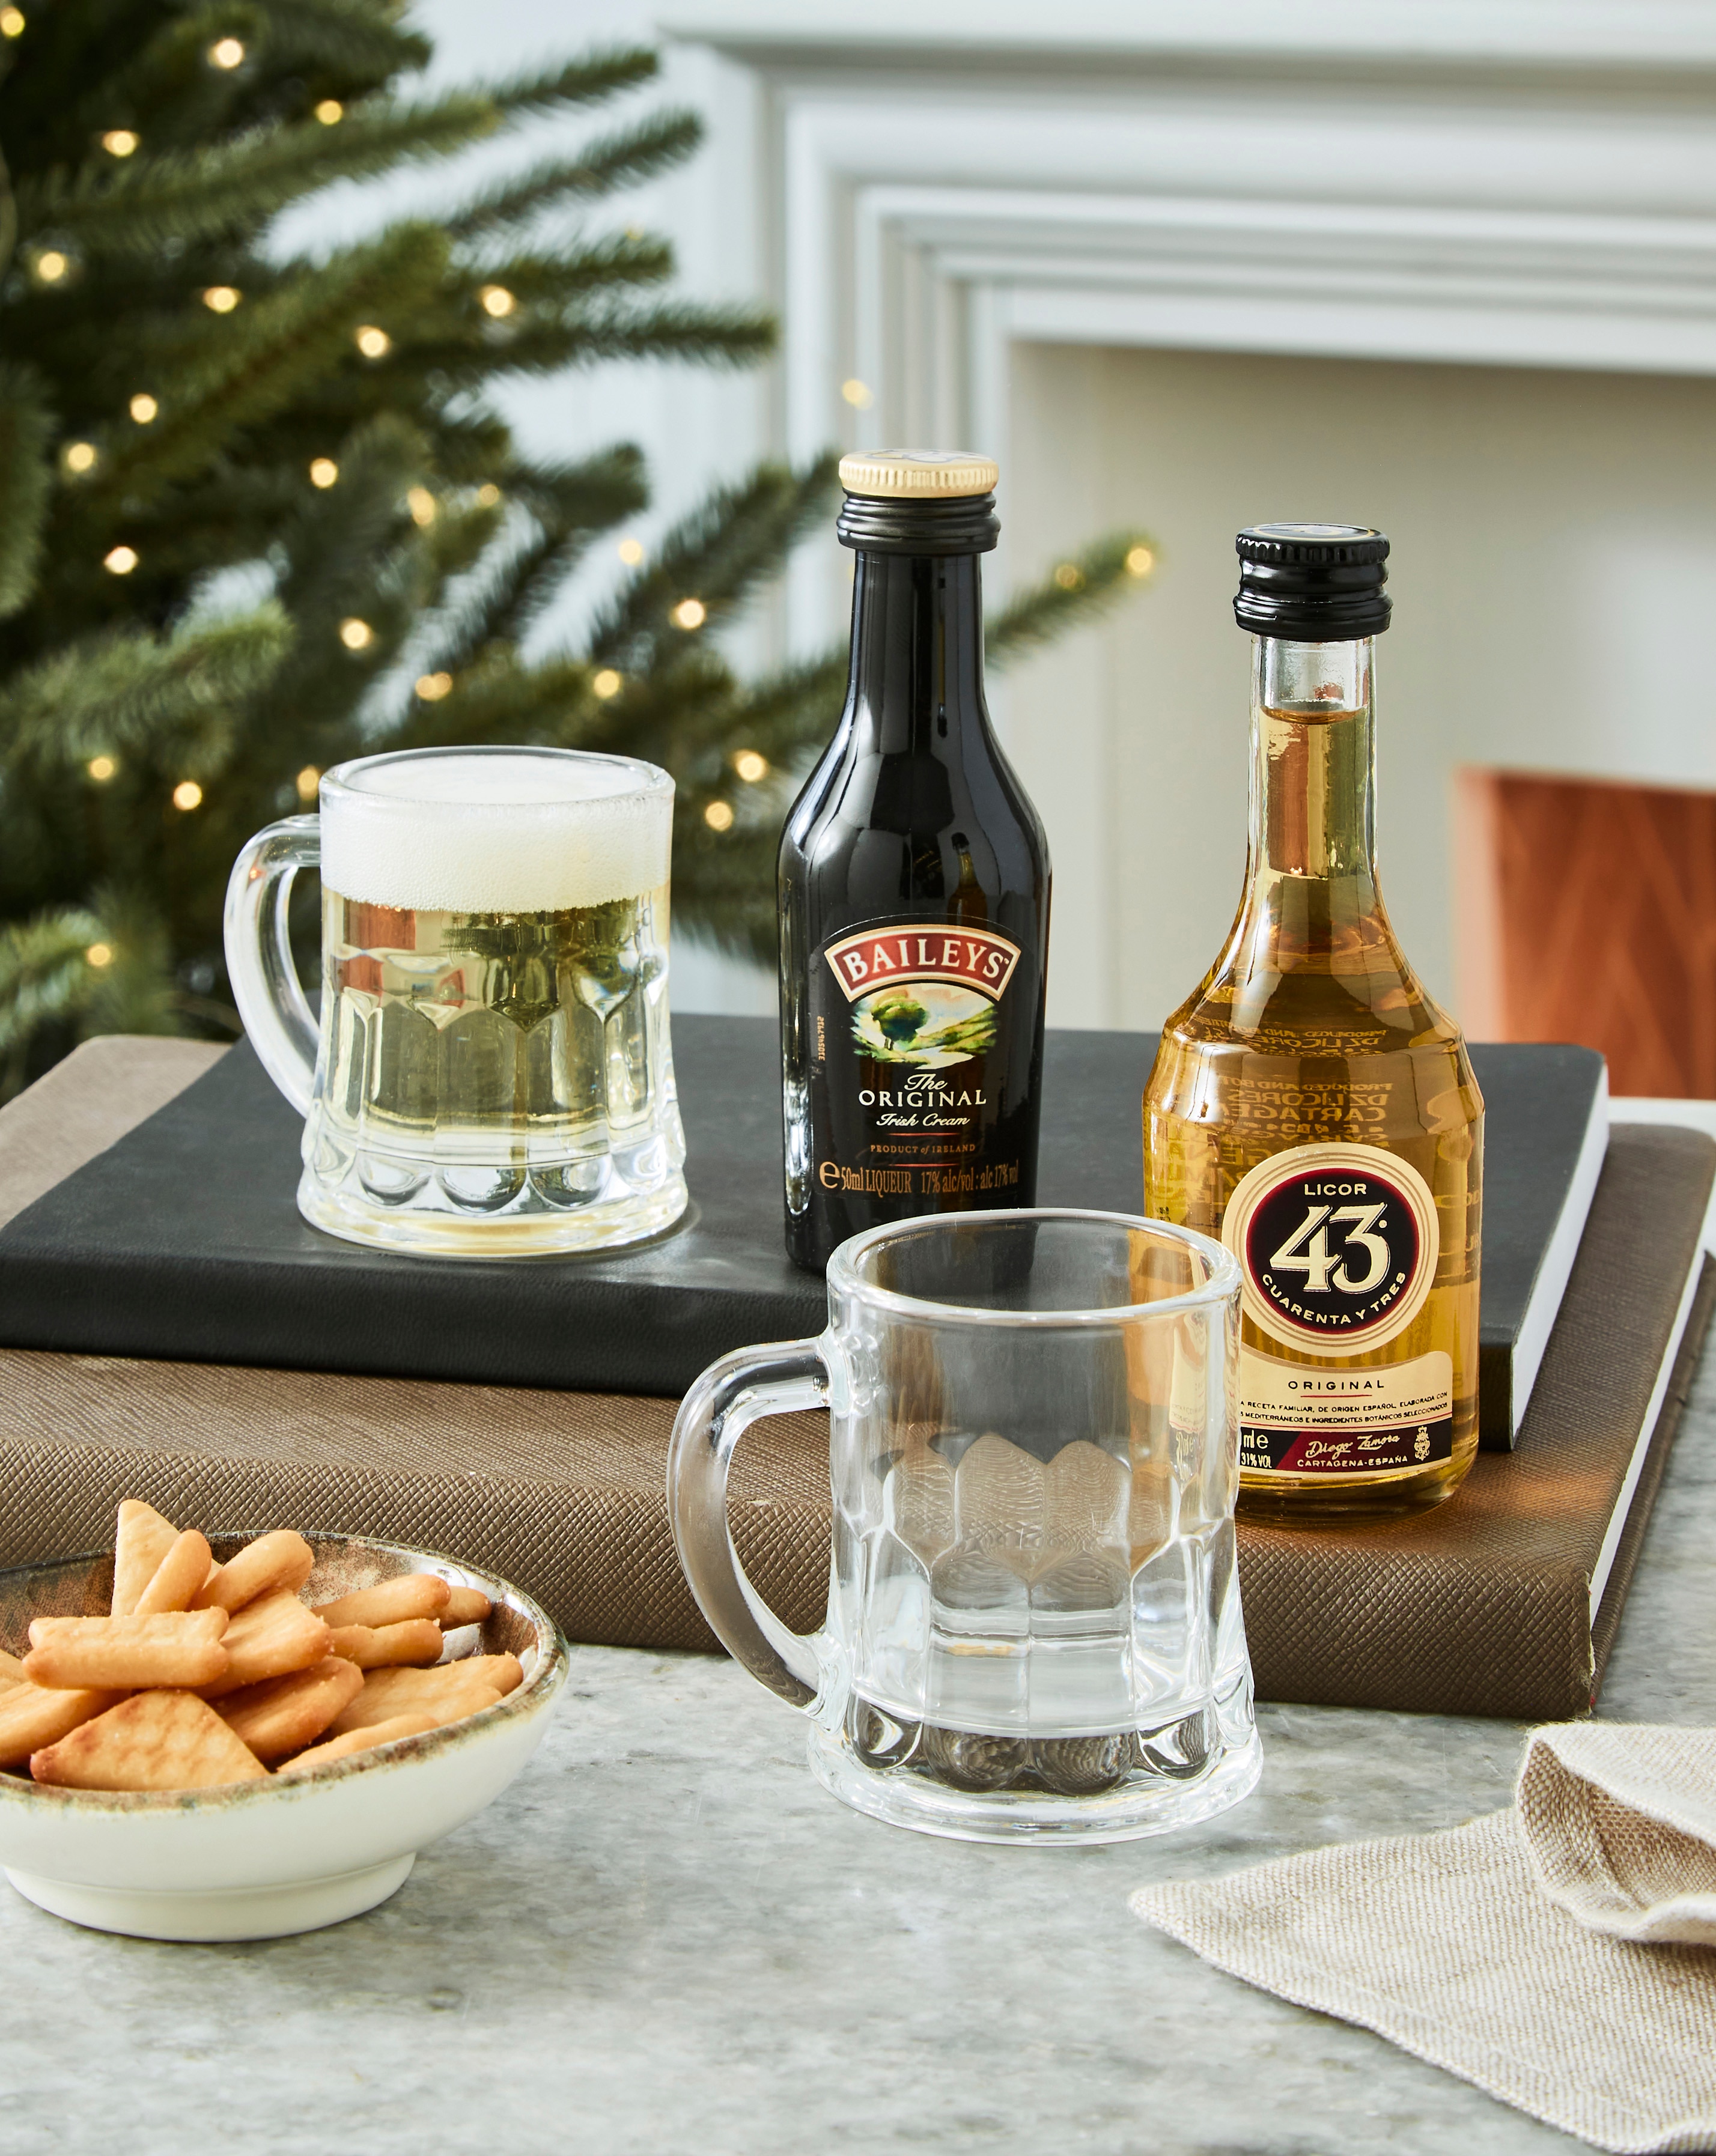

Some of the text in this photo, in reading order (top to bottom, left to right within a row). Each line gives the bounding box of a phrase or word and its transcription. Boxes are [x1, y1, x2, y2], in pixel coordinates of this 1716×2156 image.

[842, 939, 1004, 982] BAILEYS
[904, 1073, 948, 1090] The
[858, 1090, 987, 1107] ORIGINAL
[876, 1113, 970, 1126] Irish Cream
[871, 1144, 976, 1155] PRODUCT of IRELAND
[866, 1169, 912, 1198] LIQUEUR
[921, 1170, 940, 1195] 17%
[942, 1167, 974, 1193] alc/vol
[980, 1165, 993, 1189] alc
[1304, 1183, 1368, 1196] LICOR
[1269, 1201, 1391, 1295] 43
[1262, 1272, 1407, 1325] CUARENTA Y TRES
[1288, 1380, 1384, 1390] ORIGINAL
[1400, 1395, 1435, 1407] ELABORADA
[1404, 1402, 1447, 1418] SELECCIONADOS
[1241, 1430, 1255, 1448] ml
[1305, 1441, 1353, 1460] Diego
